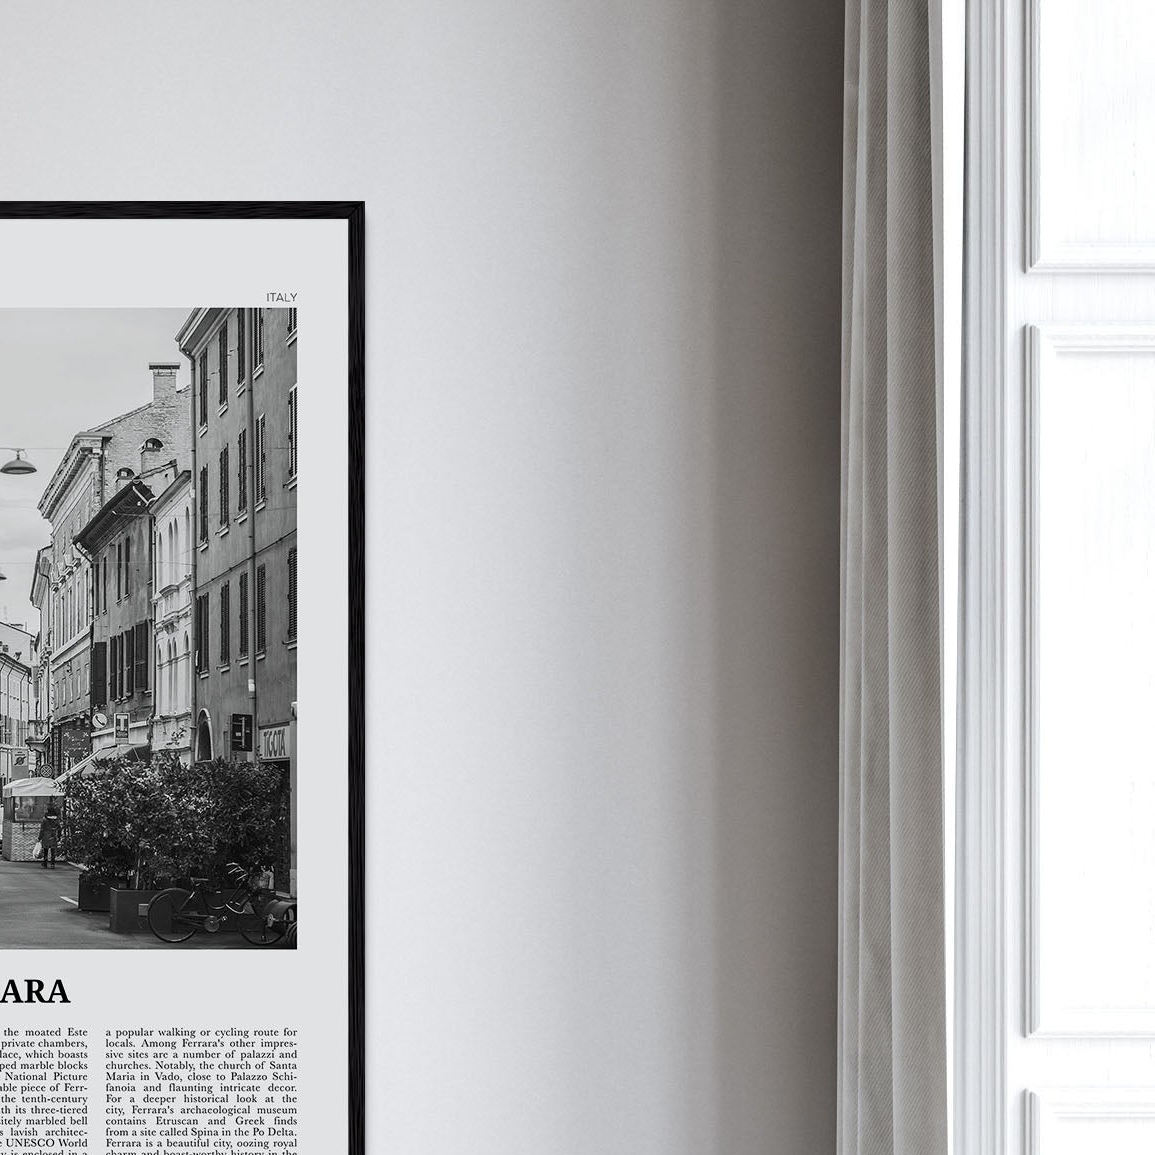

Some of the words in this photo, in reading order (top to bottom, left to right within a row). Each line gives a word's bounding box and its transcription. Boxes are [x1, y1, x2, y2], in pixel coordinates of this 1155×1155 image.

[266, 292, 298, 302] ITALY
[3, 1028, 19, 1037] the
[25, 1028, 62, 1037] moated
[67, 1028, 88, 1037] Este
[115, 1028, 155, 1039] popular
[157, 1028, 197, 1039] walking
[214, 1028, 250, 1039] cycling
[253, 1028, 279, 1037] route
[283, 1028, 298, 1037] for
[1, 1039, 36, 1050] private
[37, 1039, 88, 1049] chambers,
[105, 1039, 136, 1048] locals.
[140, 1039, 177, 1050] Among
[229, 1039, 256, 1048] other
[260, 1039, 298, 1050] impres-
[25, 1050, 54, 1059] which
[57, 1050, 89, 1059] boasts
[20, 1061, 55, 1070] marble
[57, 1061, 89, 1070] blocks
[105, 1061, 152, 1070] churches.
[155, 1061, 196, 1072] Notably,
[199, 1061, 215, 1070] the
[217, 1061, 252, 1070] church
[254, 1061, 267, 1070] of
[269, 1061, 298, 1070] Santa
[20, 1083, 47, 1095] piece
[49, 1083, 61, 1092] of
[64, 1083, 88, 1092] Ferr-
[105, 1083, 137, 1092] fanoia
[143, 1083, 162, 1092] and
[168, 1083, 214, 1095] flaunting
[220, 1083, 261, 1092] intricate
[267, 1083, 298, 1092] decor.
[0, 1094, 17, 1103] the
[21, 1094, 88, 1106] tenth-century
[105, 1105, 126, 1117] city,
[180, 1105, 251, 1117] archaeological
[25, 1117, 66, 1125] marbled
[69, 1117, 88, 1125] bell
[105, 1117, 147, 1125] contains
[155, 1117, 199, 1125] Etruscan
[207, 1117, 226, 1125] and
[235, 1117, 265, 1125] Greek
[273, 1117, 298, 1125] finds
[105, 1128, 129, 1137] from
[139, 1128, 157, 1137] site
[159, 1128, 188, 1137] called
[190, 1128, 219, 1139] Spina
[221, 1128, 232, 1137] in
[234, 1128, 250, 1137] the
[252, 1128, 265, 1137] Po
[267, 1128, 297, 1137] Delta.
[5, 1139, 55, 1148] UNESCO
[57, 1139, 88, 1148] World
